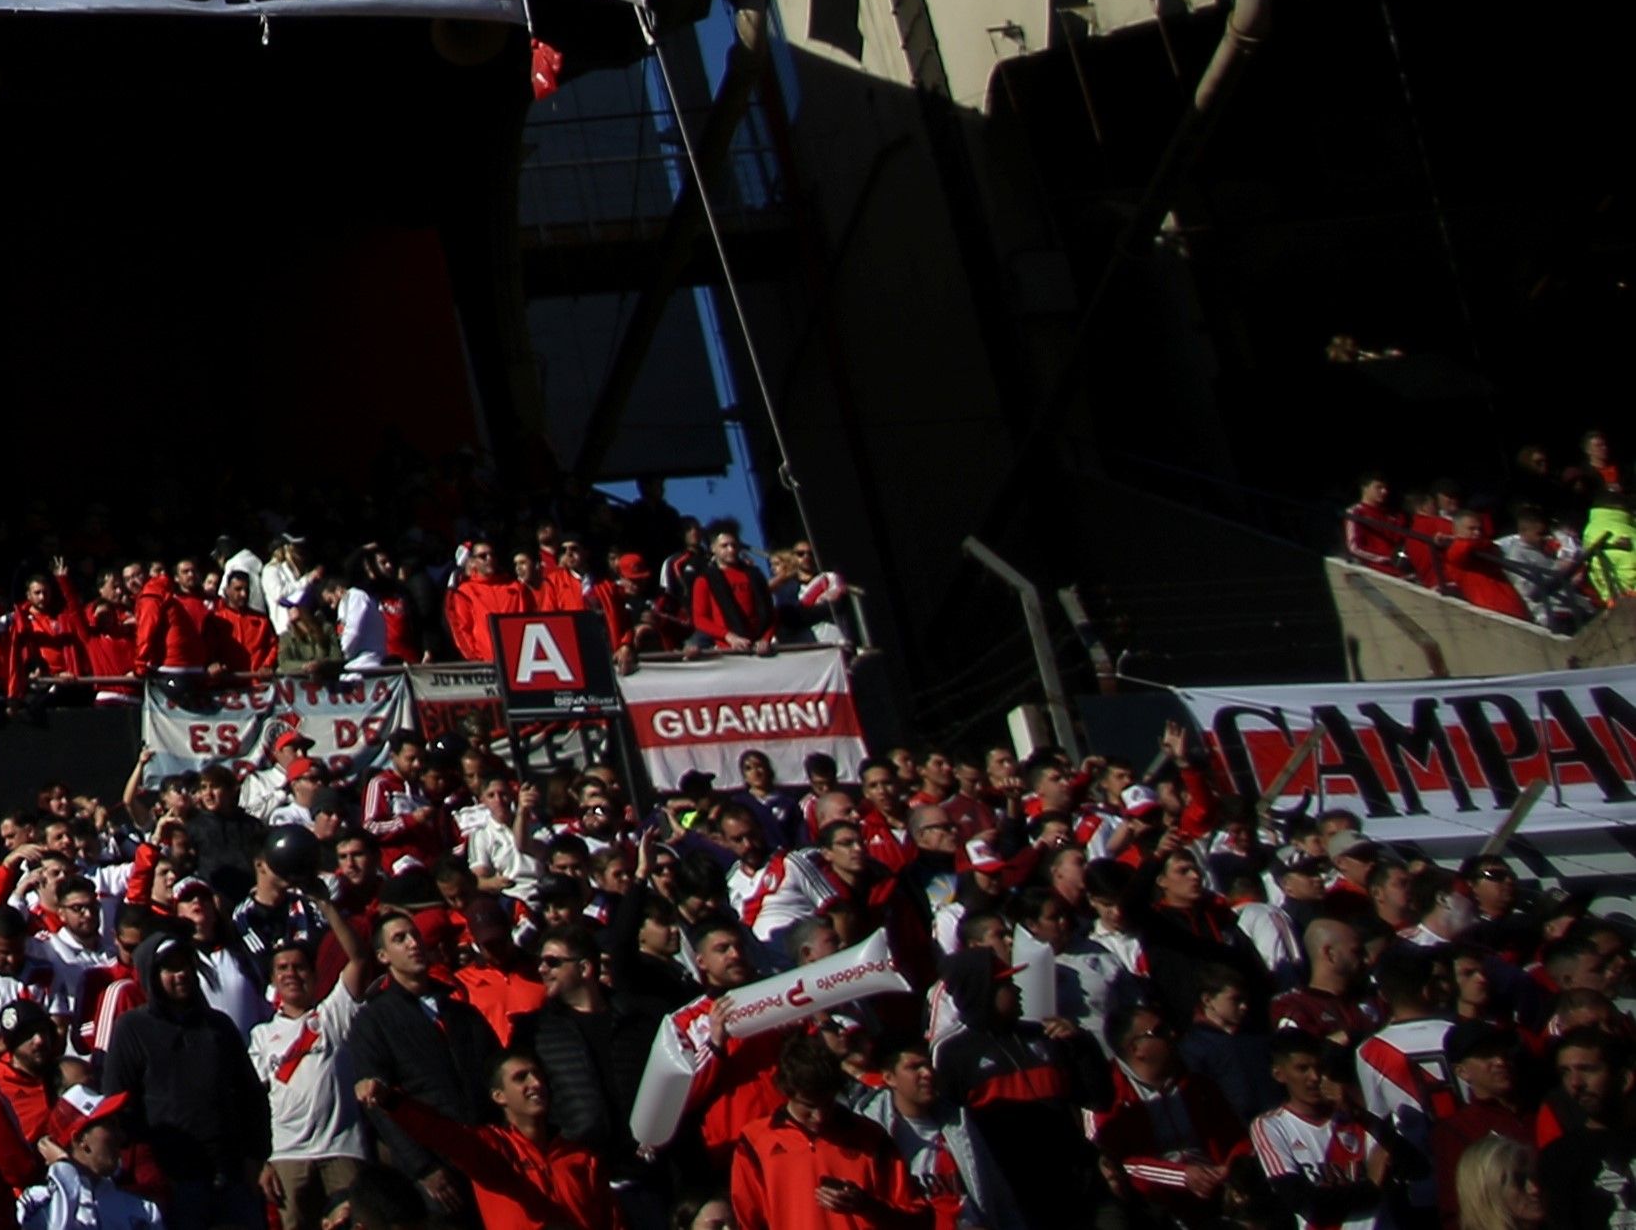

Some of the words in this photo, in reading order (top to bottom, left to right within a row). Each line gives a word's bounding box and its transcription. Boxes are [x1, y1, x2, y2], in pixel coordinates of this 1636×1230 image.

[515, 623, 575, 683] A
[652, 701, 829, 739] GUAMINI
[189, 723, 241, 757] ES
